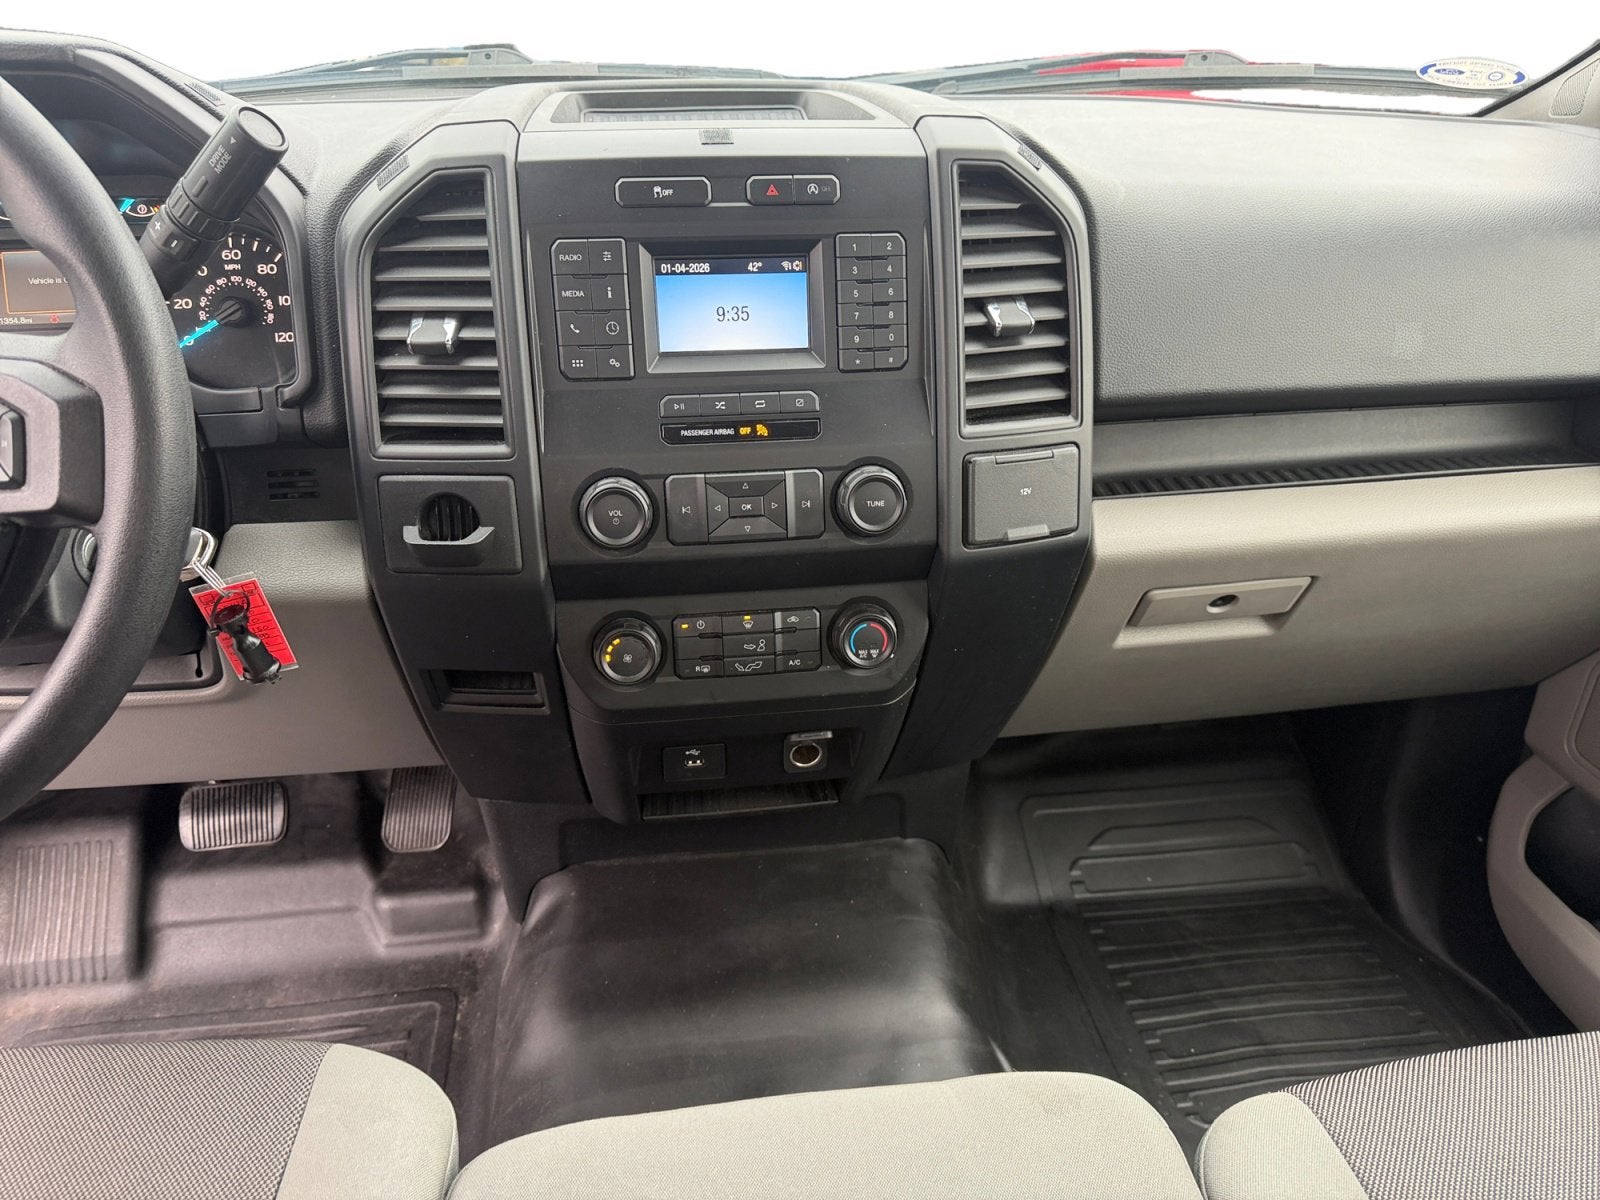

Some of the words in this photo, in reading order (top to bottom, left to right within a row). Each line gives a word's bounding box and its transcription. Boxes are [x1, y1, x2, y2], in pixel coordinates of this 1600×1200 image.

[208, 144, 226, 167] DRIVE
[214, 151, 232, 174] MODE
[852, 243, 857, 252] 1
[886, 242, 892, 250] 2
[221, 249, 242, 260] 60
[197, 266, 208, 276] 0
[256, 264, 278, 274] 80
[660, 262, 711, 274] 01-04-2026
[747, 262, 762, 272] 42°
[852, 266, 858, 274] 3
[886, 264, 892, 272] 4
[28, 276, 54, 284] Vehicle
[216, 277, 228, 286] 80
[245, 278, 257, 288] 120
[205, 284, 216, 294] 60
[853, 289, 859, 298] 5
[888, 287, 894, 296] 6
[173, 298, 193, 310] 20
[278, 295, 291, 306] 10
[716, 306, 750, 322] 9:35
[853, 312, 859, 320] 7
[888, 310, 894, 319] 8
[274, 332, 295, 343] 120
[854, 335, 859, 343] 9
[889, 333, 894, 341] 0
